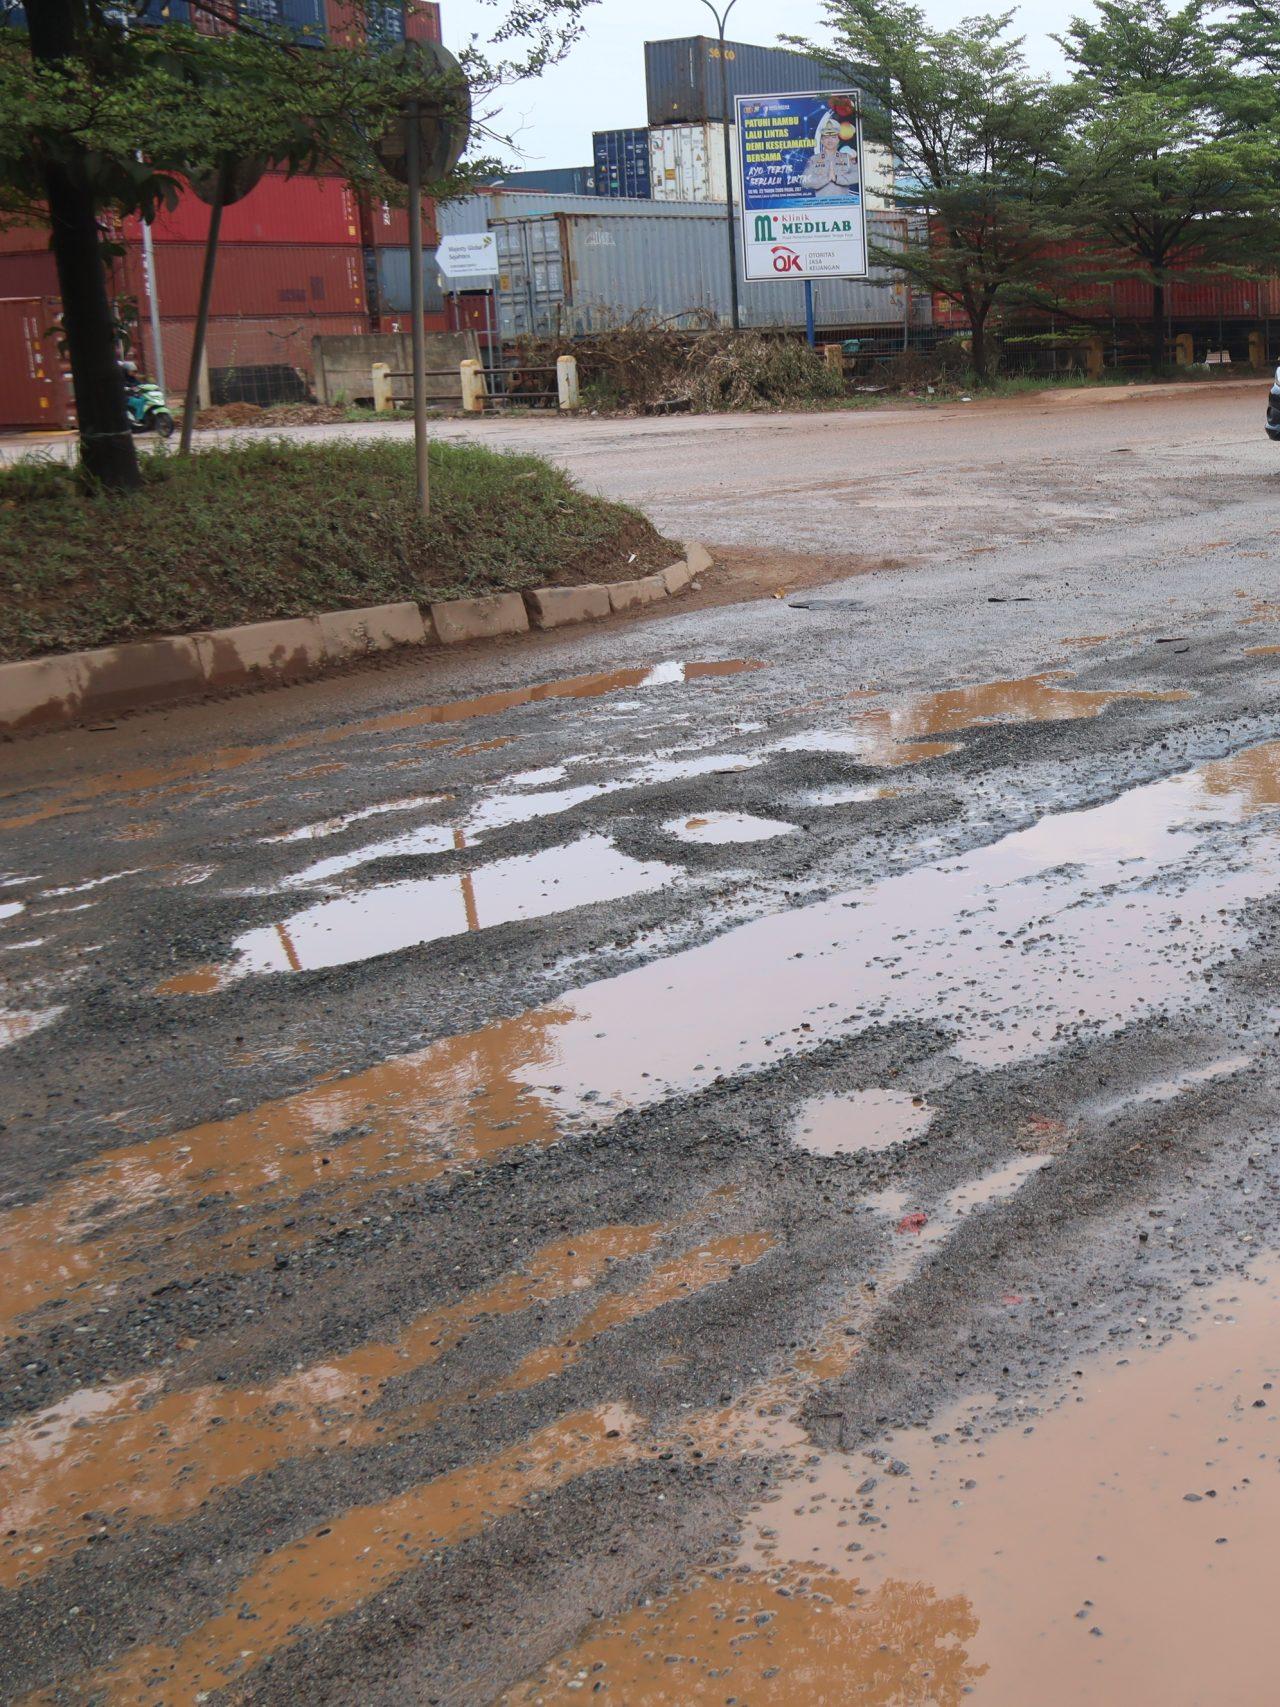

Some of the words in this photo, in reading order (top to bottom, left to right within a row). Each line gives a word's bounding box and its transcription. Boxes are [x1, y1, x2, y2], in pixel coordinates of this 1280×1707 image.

[745, 118, 771, 127] PATUHI
[772, 117, 799, 126] RAMBU
[746, 131, 762, 139] LALU
[764, 130, 788, 138] LINTAS
[746, 142, 764, 151] DEMI
[765, 139, 817, 150] KESELAMATAN
[747, 153, 781, 162] BERSAMA
[748, 167, 764, 176] AYO
[781, 214, 810, 222] Klinik
[781, 220, 852, 234] MEDILAB
[773, 255, 803, 272] OJK
